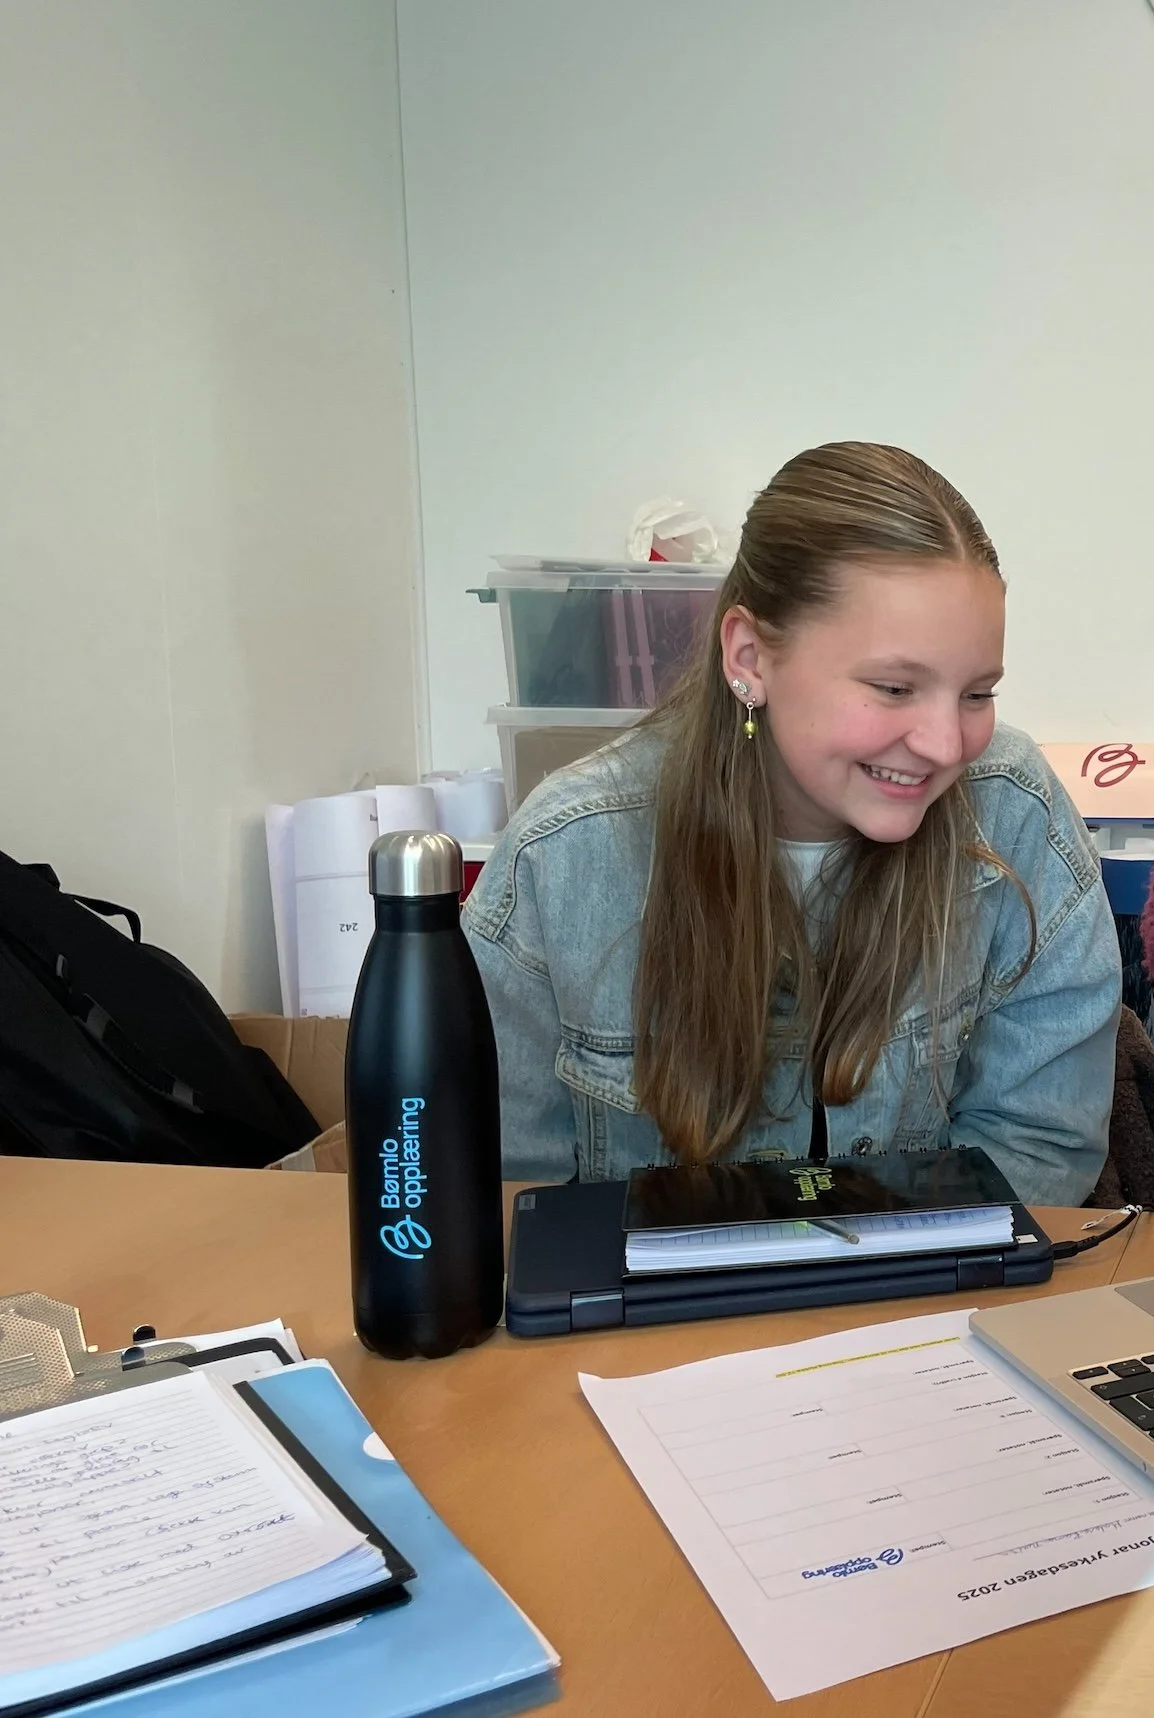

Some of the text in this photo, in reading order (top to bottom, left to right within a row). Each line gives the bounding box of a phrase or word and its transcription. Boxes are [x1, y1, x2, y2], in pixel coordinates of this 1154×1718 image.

[339, 922, 359, 933] 242
[398, 1097, 428, 1209] opplæring
[379, 1138, 401, 1209] Bømlo
[1101, 1491, 1130, 1502] Stasjon
[1003, 1550, 1109, 1587] yrkesdagen
[956, 1582, 1002, 1602] 2025
